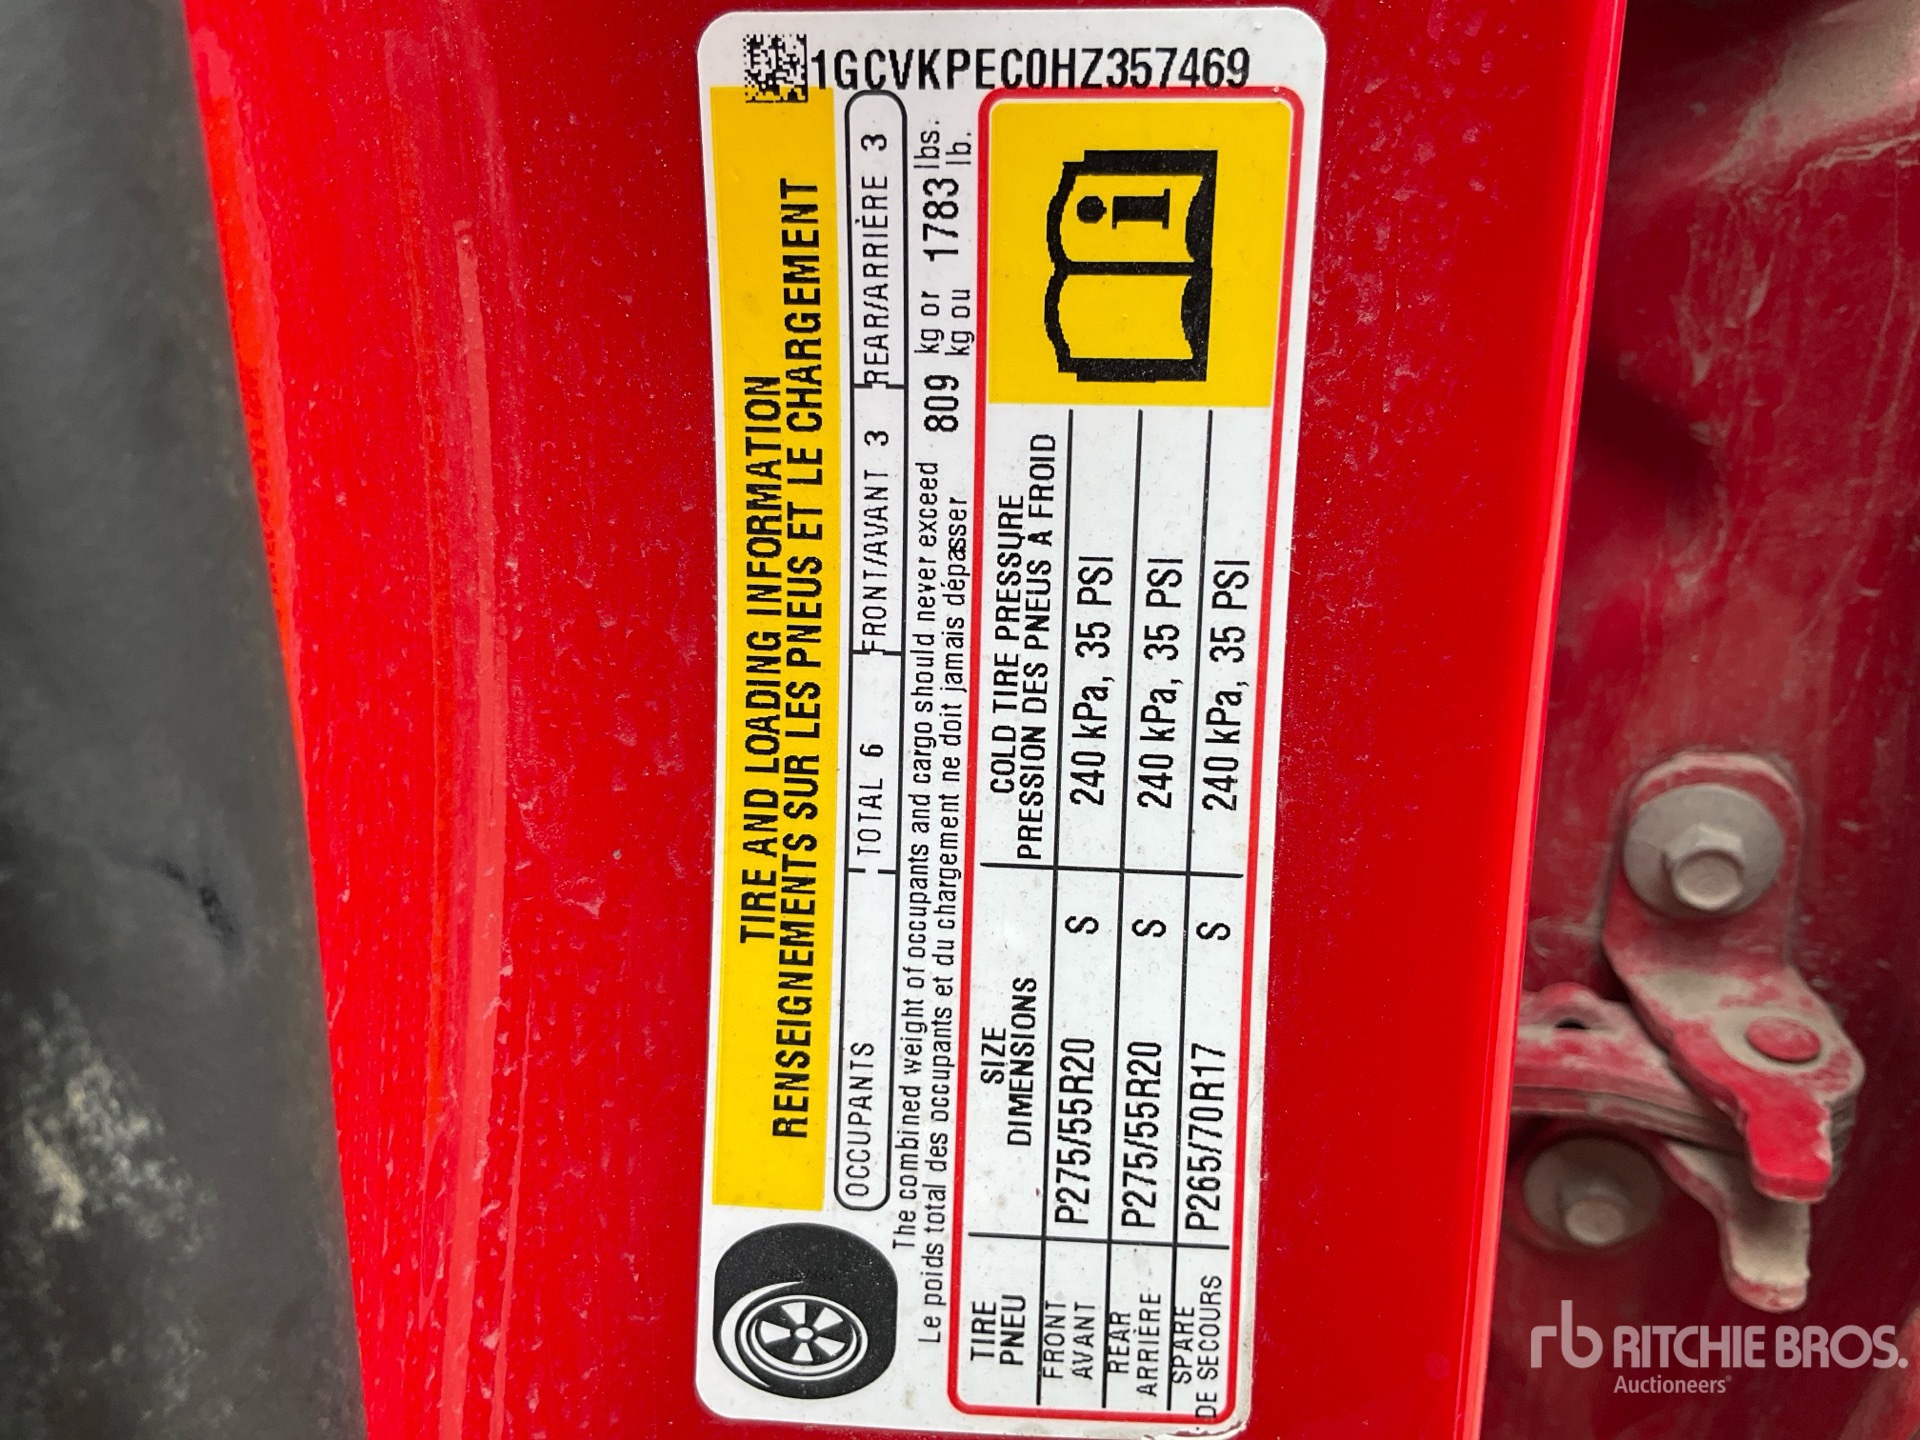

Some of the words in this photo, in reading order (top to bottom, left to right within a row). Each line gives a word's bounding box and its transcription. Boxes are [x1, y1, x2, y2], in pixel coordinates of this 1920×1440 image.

[810, 46, 1250, 91] 1GCVKPEC0HZ357469
[860, 133, 888, 152] 3
[913, 120, 940, 169] lbs.
[945, 132, 972, 165] lb.
[922, 177, 960, 262] 1783
[779, 177, 823, 433] CHARGEMENT
[853, 173, 890, 386] REAR/ARRIÈRE
[920, 290, 940, 317] or
[951, 289, 971, 319] ou
[913, 328, 945, 354] kg
[944, 330, 975, 356] kg
[923, 374, 960, 433] 809
[786, 447, 823, 486] LE
[863, 430, 889, 447] 3
[743, 376, 783, 616] INFORMATION
[914, 462, 938, 548] exceed
[1028, 433, 1056, 519] FROID
[786, 500, 823, 541] ET
[940, 496, 971, 606] dépasser
[861, 467, 890, 653] FRONT/AVANT
[916, 556, 937, 622] never
[994, 494, 1024, 641] PRESSURE
[1076, 555, 1114, 606] PSI
[1145, 558, 1184, 609] PSI
[1211, 560, 1251, 610] PSI
[786, 555, 823, 668] PNEUS
[1024, 559, 1052, 650] PNEUS
[939, 616, 968, 693] jamais
[1074, 621, 1111, 659] 35
[1143, 624, 1180, 661] 35
[1209, 626, 1246, 663] 35
[744, 630, 782, 774] LOADING
[909, 633, 935, 713] should
[992, 652, 1019, 714] TIRE
[1021, 662, 1049, 714] DES
[784, 681, 821, 739] LES
[938, 703, 963, 747] doit
[1071, 676, 1115, 740] kPa,
[1139, 678, 1184, 742] kPa,
[1204, 681, 1250, 745] kPa,
[859, 743, 884, 758] 6
[912, 721, 937, 784] cargo
[942, 756, 961, 782] ne
[989, 724, 1017, 794] COLD
[1069, 750, 1106, 806] 240
[1136, 753, 1174, 809] 240
[783, 754, 820, 820] SUR
[907, 793, 931, 834] and
[1016, 725, 1047, 860] PRESSION
[1201, 756, 1239, 811] 240
[742, 788, 779, 858] AND
[856, 778, 883, 856] TOTAL
[932, 793, 962, 930] chargement
[739, 869, 777, 944] TIRE
[907, 843, 932, 959] occupants
[1064, 915, 1100, 935] S
[1131, 918, 1167, 938] S
[1195, 921, 1231, 941] S
[902, 966, 925, 989] of
[931, 939, 955, 967] du
[772, 833, 818, 1138] RENSEIGNEMENTS
[932, 976, 954, 997] et
[900, 998, 928, 1075] weight
[930, 1006, 956, 1122] occupants
[980, 1026, 1007, 1085] SIZE
[1007, 977, 1037, 1147] DIMENSIONS
[845, 1042, 875, 1197] OCCUPANTS
[894, 1085, 921, 1200] combined
[1054, 1037, 1095, 1225] P275/55R20
[1120, 1041, 1162, 1228] P275/55R20
[1184, 1042, 1226, 1231] P265/70R17
[924, 1132, 948, 1172] des
[892, 1210, 917, 1250] The
[921, 1183, 946, 1234] total
[920, 1243, 947, 1306] poids
[918, 1316, 942, 1343] Le
[970, 1301, 997, 1362] TIRE
[999, 1294, 1026, 1366] PNEU
[1042, 1300, 1066, 1379] FRONT
[1071, 1301, 1096, 1381] AVANT
[1107, 1311, 1131, 1374] REAR
[1132, 1293, 1161, 1398] ARRIÈRE
[1171, 1305, 1195, 1384] SPARE
[1196, 1275, 1222, 1380] SECOURS
[1195, 1392, 1217, 1419] DE
